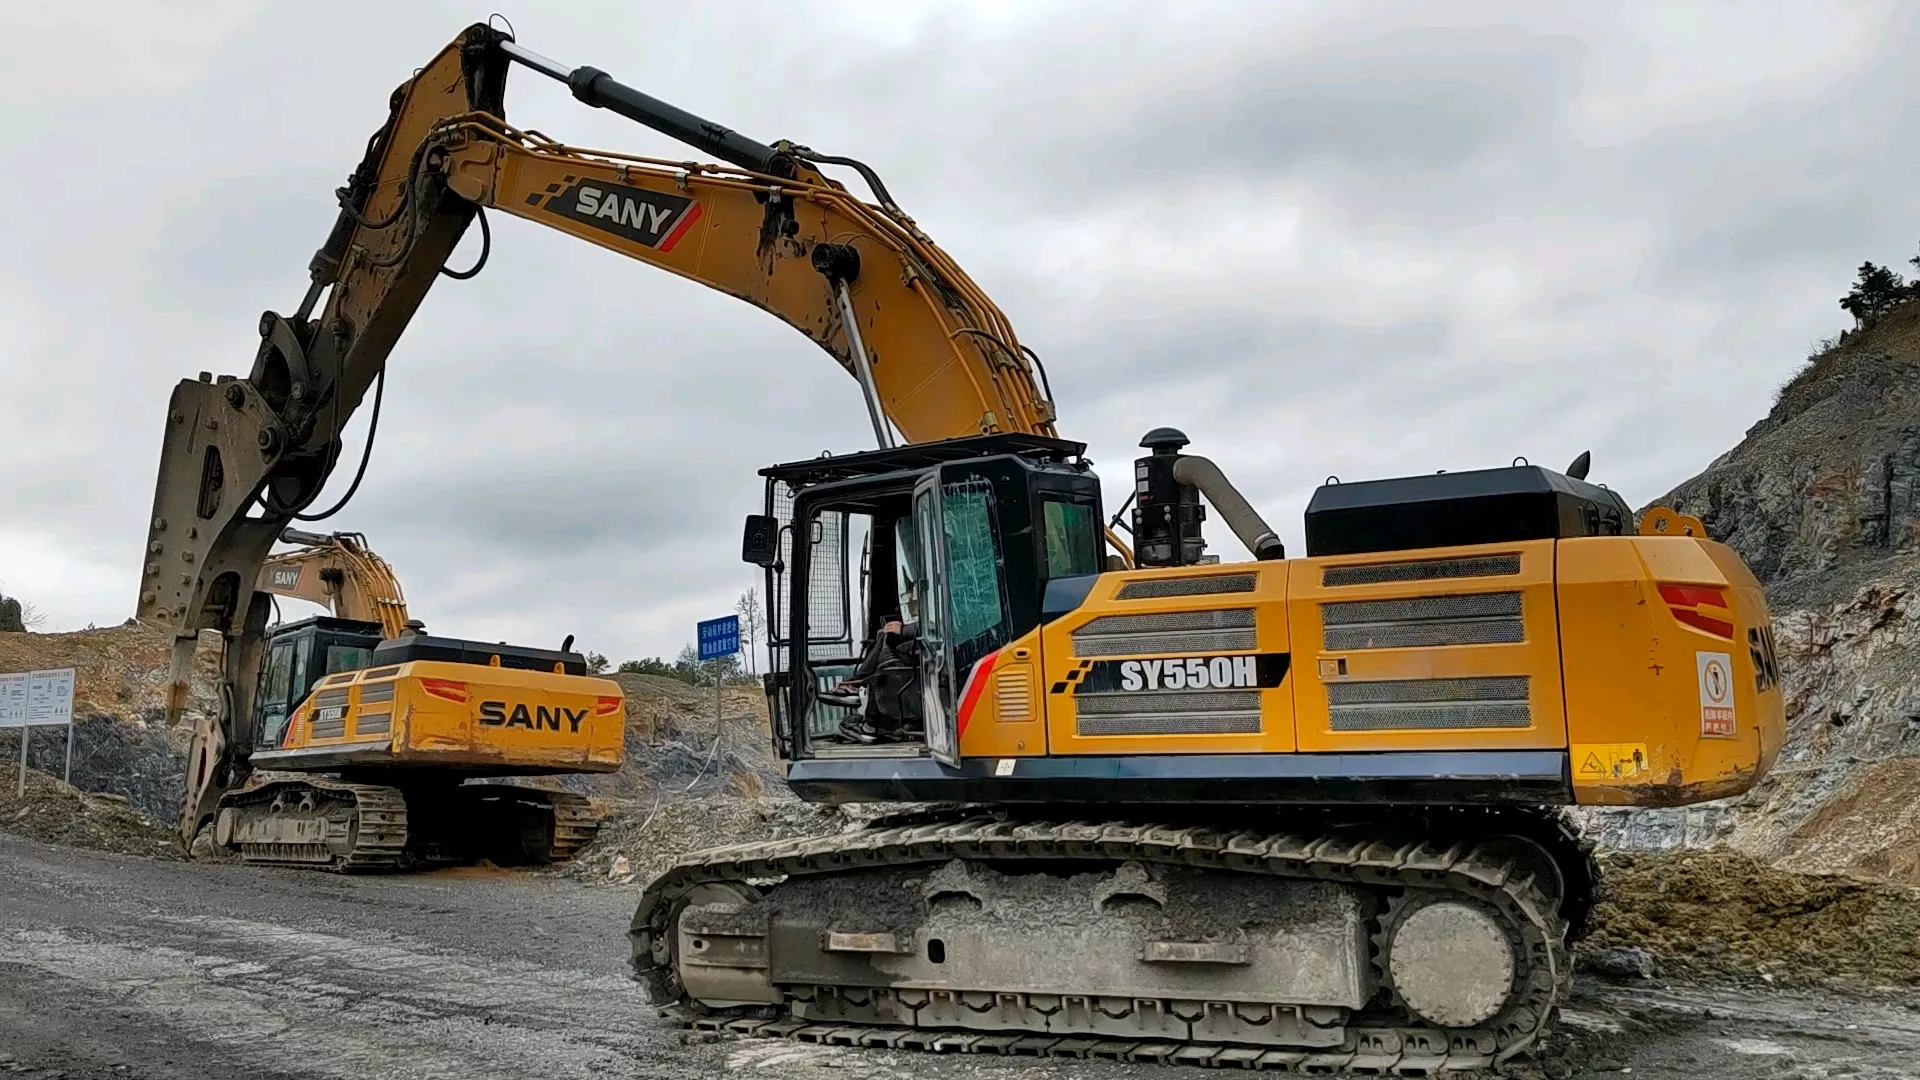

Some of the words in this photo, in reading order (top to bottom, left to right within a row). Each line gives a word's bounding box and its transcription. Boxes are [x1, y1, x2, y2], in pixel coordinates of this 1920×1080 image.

[575, 186, 673, 235] SANY
[274, 571, 299, 585] SANY
[1120, 656, 1258, 691] SY550H
[478, 701, 589, 735] SANY
